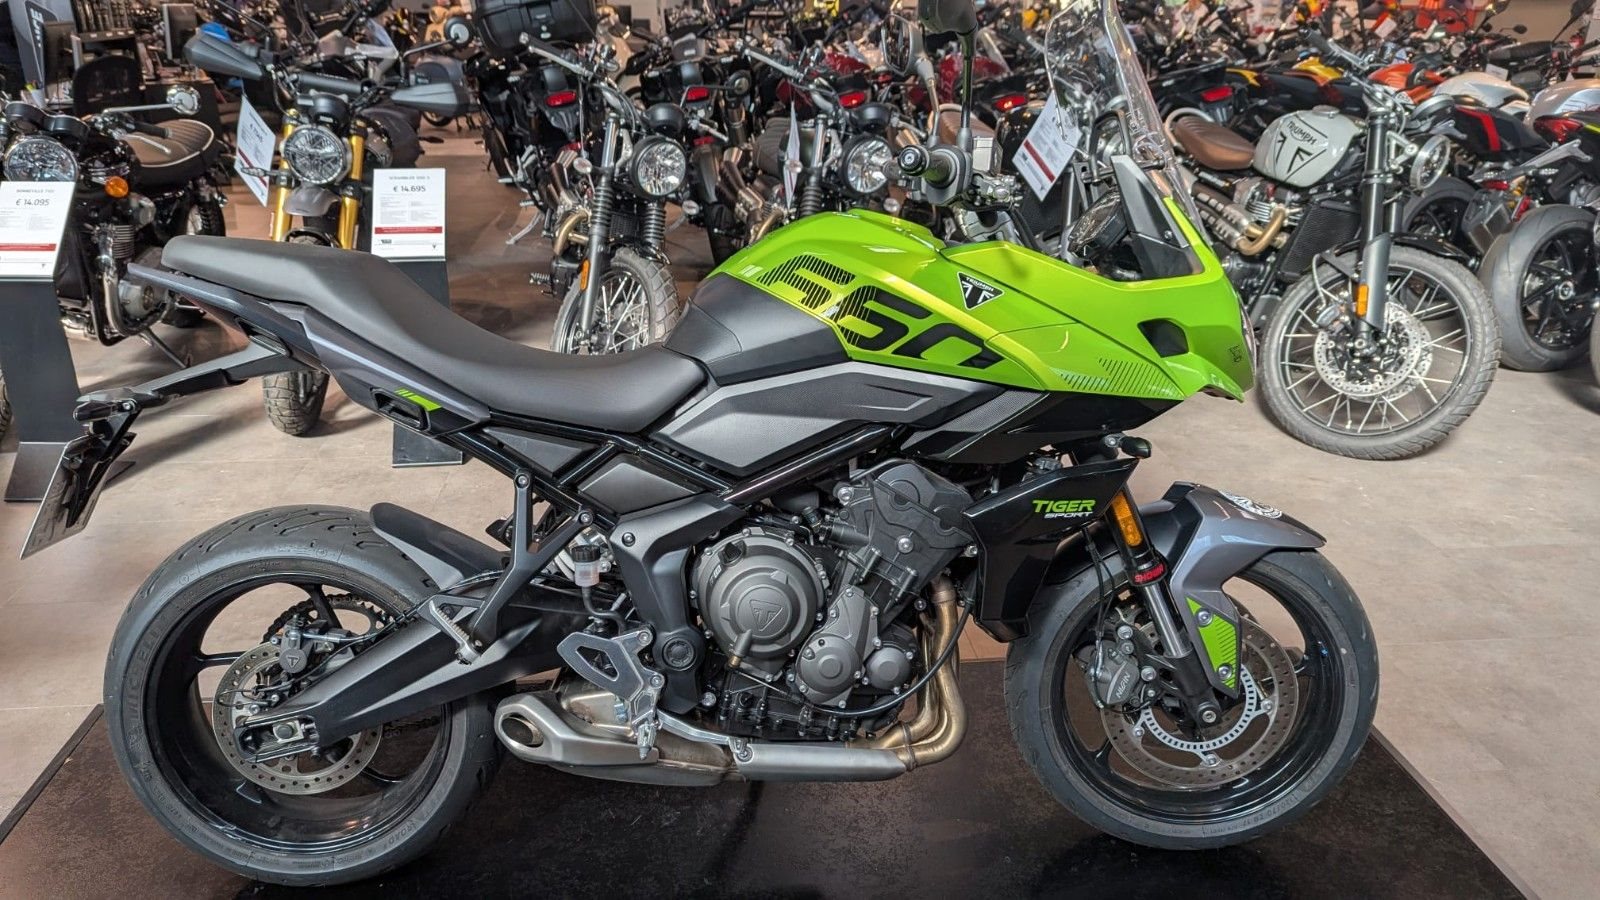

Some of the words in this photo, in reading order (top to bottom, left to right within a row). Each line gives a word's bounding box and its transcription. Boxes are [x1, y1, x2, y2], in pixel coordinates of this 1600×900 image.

[1287, 120, 1318, 146] TRIUMPH
[400, 185, 427, 193] 14.695
[23, 198, 50, 206] 14.095
[966, 276, 994, 292] TRIUMPH
[756, 254, 1007, 369] 660
[1032, 499, 1096, 513] TIGER
[1044, 511, 1094, 519] SPORT
